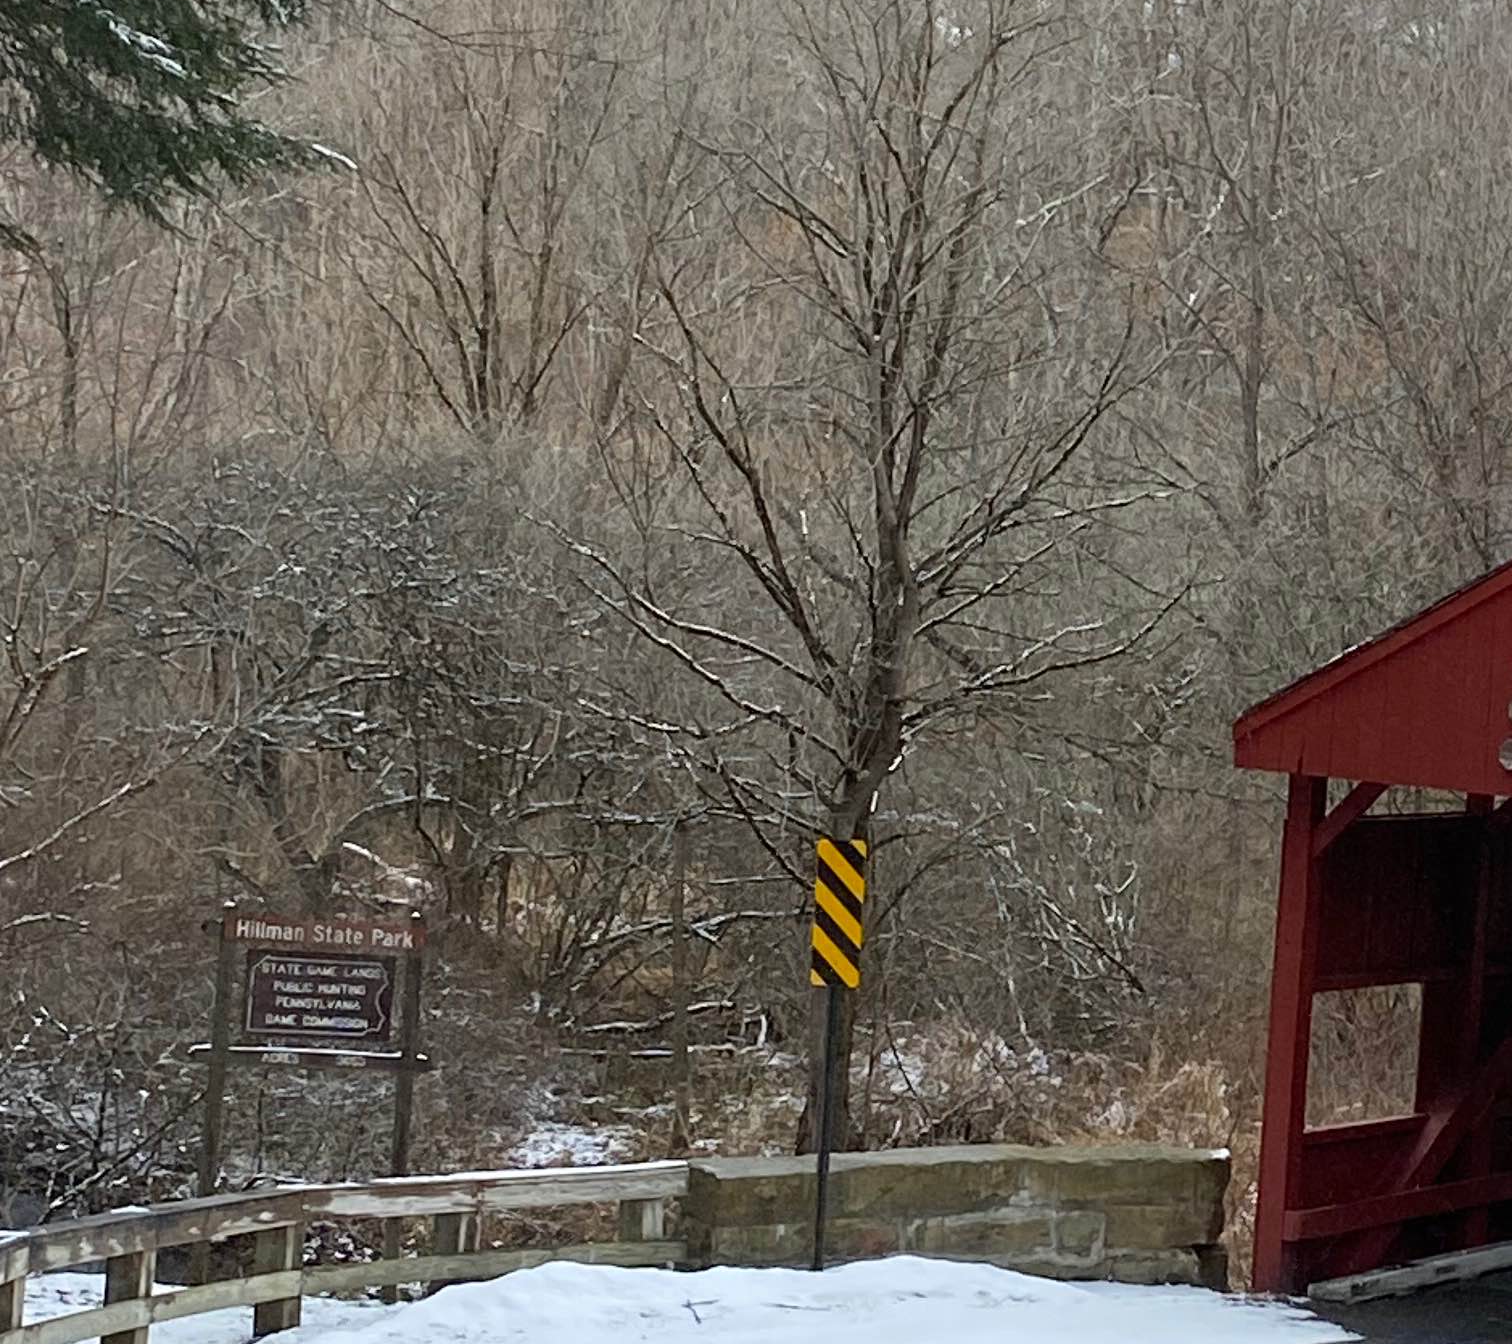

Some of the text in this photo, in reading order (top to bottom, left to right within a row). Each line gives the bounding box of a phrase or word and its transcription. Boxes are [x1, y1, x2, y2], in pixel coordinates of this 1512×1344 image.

[236, 918, 413, 948] Hillman State Park
[261, 962, 302, 975] STATE
